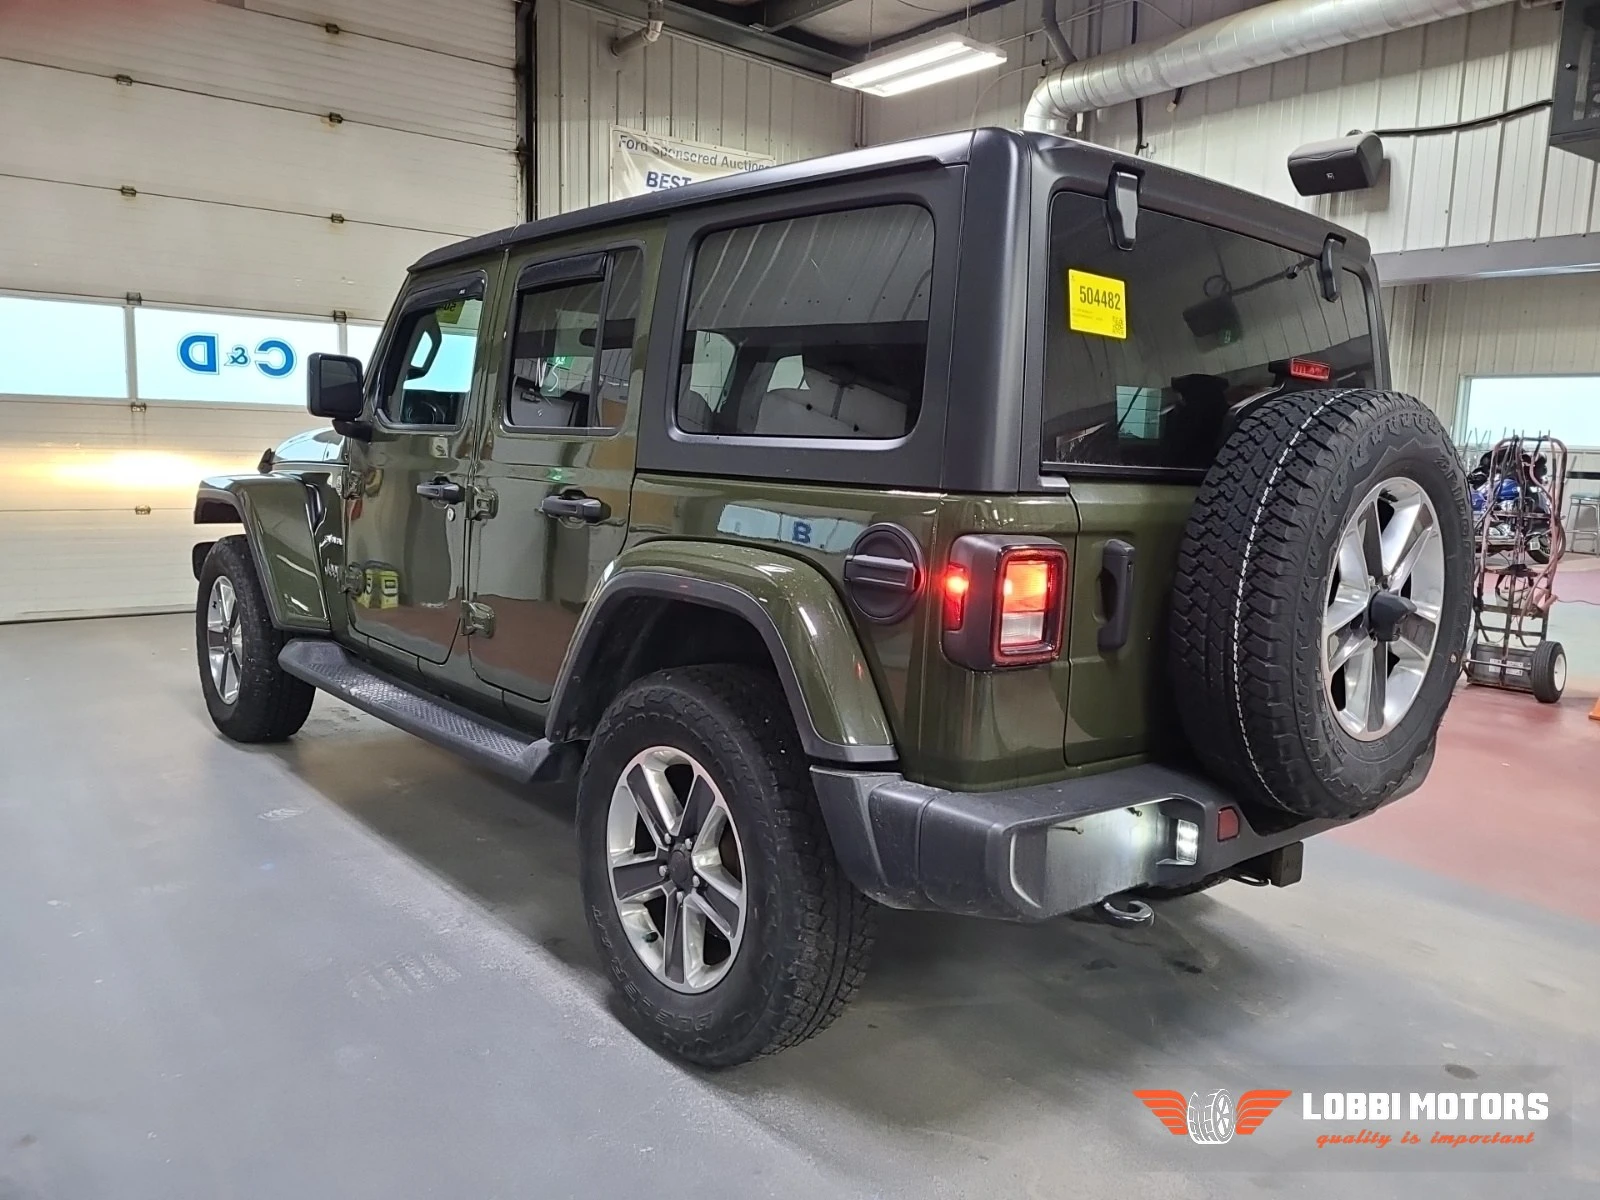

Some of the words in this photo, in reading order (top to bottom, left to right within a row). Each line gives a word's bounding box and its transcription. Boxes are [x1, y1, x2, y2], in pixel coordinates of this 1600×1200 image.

[618, 135, 649, 152] Ford
[720, 156, 771, 172] Auction
[646, 171, 692, 189] BEST
[1079, 285, 1121, 311] 504482
